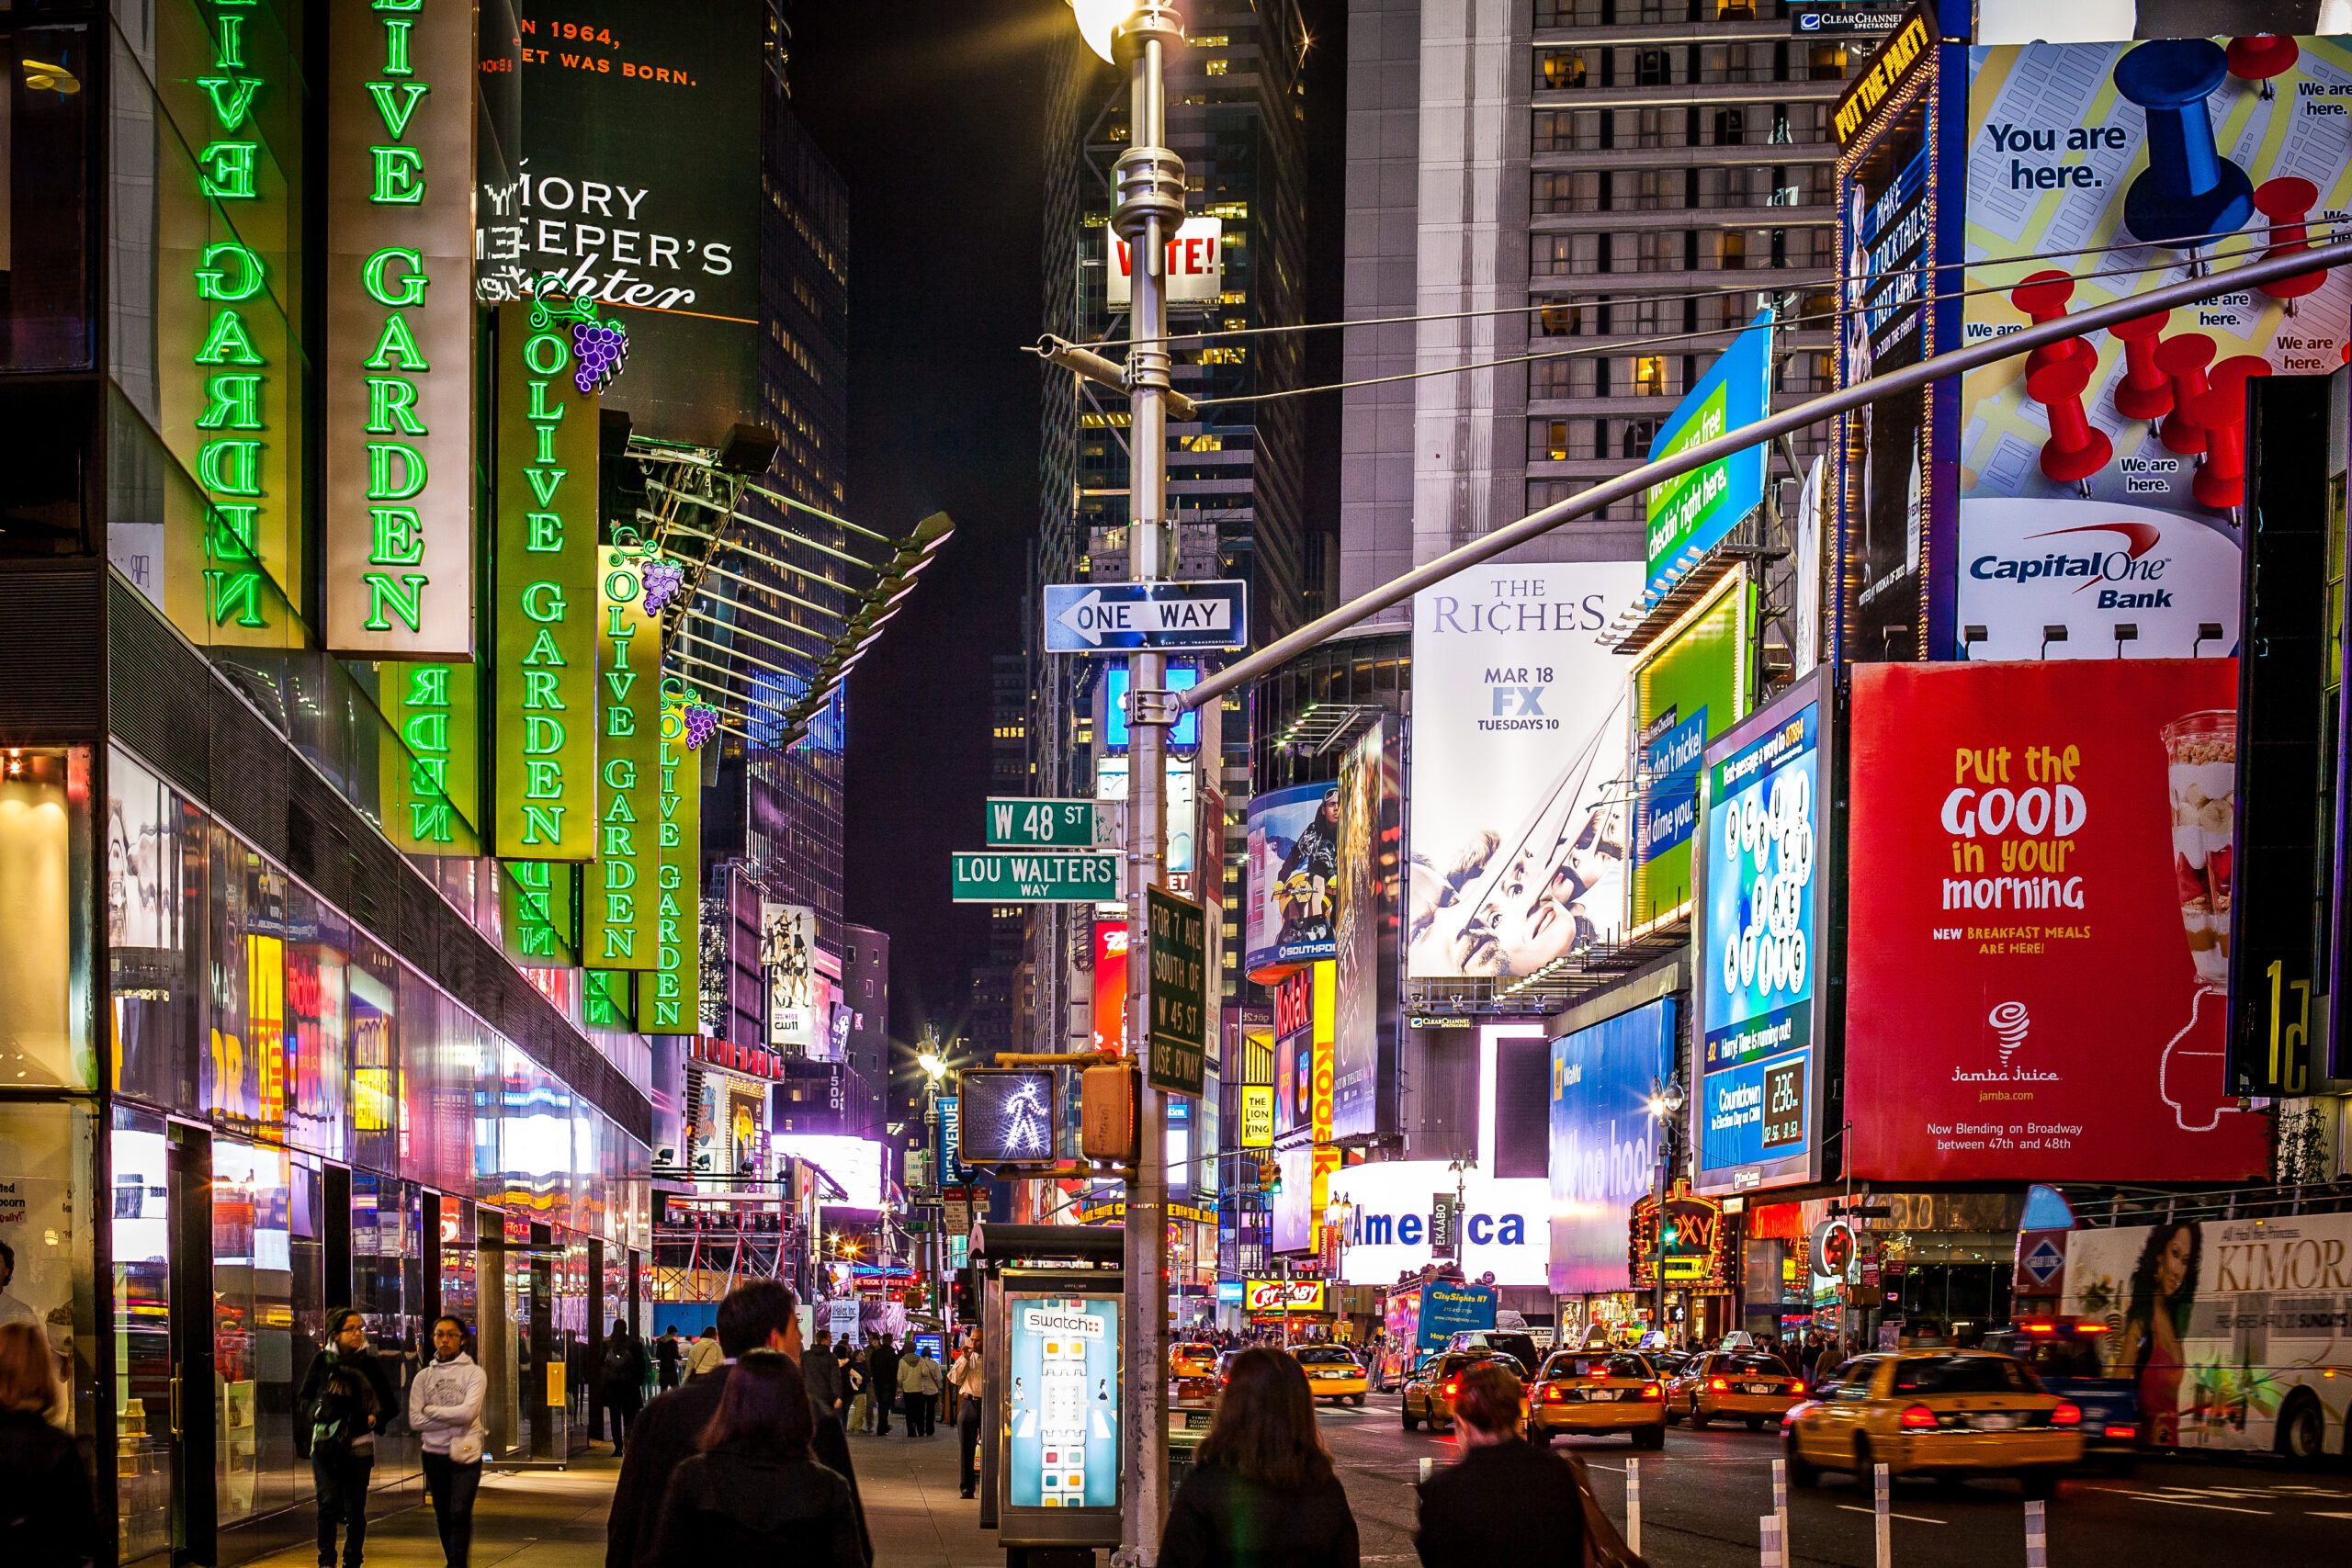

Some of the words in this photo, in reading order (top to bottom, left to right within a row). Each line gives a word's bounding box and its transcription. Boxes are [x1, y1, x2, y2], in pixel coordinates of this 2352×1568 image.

[551, 22, 620, 50] 1964,
[560, 53, 610, 73] WAS
[622, 62, 696, 86] BORN.
[1834, 93, 1862, 143] PUT
[1857, 63, 1888, 113] THE
[1882, 14, 1929, 85] PARTY
[2299, 82, 2325, 96] We
[2328, 84, 2352, 96] are
[2306, 101, 2347, 116] here.
[1986, 124, 2056, 153] You
[2067, 126, 2127, 151] are
[2011, 160, 2103, 190] here.
[1876, 175, 1902, 235] MAKE
[1875, 197, 1928, 281] COCKTAILS
[1117, 237, 1215, 276] VTE!
[1894, 259, 1917, 310] WAR
[2222, 294, 2249, 307] are
[1900, 312, 1917, 339] PARTY
[1967, 323, 1993, 337] We
[2199, 312, 2241, 327] here.
[2277, 336, 2305, 350] We
[2308, 338, 2334, 349] are
[2283, 355, 2325, 369] here.
[364, 248, 430, 631] GARDEN
[525, 334, 569, 553] OLIVE
[2120, 458, 2148, 472] We
[2152, 460, 2177, 471] are
[2128, 477, 2170, 491] here.
[1680, 483, 1702, 535] right
[1702, 466, 1727, 509] here.
[1490, 580, 1545, 597] THE
[2098, 589, 2173, 610] Bank
[1077, 604, 1132, 630] ONE
[1159, 603, 1218, 627] WAY
[604, 569, 639, 738] OLIVE
[1485, 668, 1529, 683] MAR
[1536, 667, 1554, 682] 18
[520, 581, 568, 845] GARDEN
[1492, 686, 1545, 716] FX
[1477, 719, 1544, 731] TUESDAYS
[1545, 719, 1560, 730] 10
[1654, 740, 1675, 785] don't
[1675, 719, 1702, 770] nickel
[2024, 744, 2081, 784] the
[658, 712, 682, 848] OLIVE
[994, 804, 1014, 840] W
[1023, 805, 1054, 841] 48
[1064, 806, 1085, 825] ST
[1653, 807, 1672, 844] dime
[1673, 798, 1693, 841] you.
[1940, 784, 2087, 839] GOOD
[602, 758, 637, 960] GARDEN
[958, 858, 1001, 883] LOU
[1011, 858, 1112, 883] WALTERS
[1952, 841, 1984, 873] in
[2001, 840, 2075, 874] your
[1020, 884, 1050, 897] WAY
[1151, 903, 1170, 939] FOR
[1184, 918, 1202, 952] AVE
[1933, 928, 1962, 941] NEW
[1967, 926, 2041, 939] BREAKFAST
[2044, 925, 2091, 939] MEALS
[655, 863, 682, 1027] GARDEN
[1979, 943, 2005, 954] ARE
[2009, 942, 2044, 954] HERE!
[1155, 950, 1185, 988] SOUTH
[1188, 964, 1200, 993] OF
[1159, 996, 1167, 1028] W
[1170, 1002, 1183, 1032] 45
[1276, 969, 1309, 1037] Kodak
[1153, 1043, 1171, 1077] USE
[1174, 1048, 1201, 1089] B'WAY
[1563, 1063, 1583, 1087] WaMu
[830, 1064, 840, 1110] 1500
[1249, 1097, 1267, 1106] THE
[1718, 1083, 1761, 1113] Countdown
[1979, 1090, 2034, 1102] jamba.com
[1246, 1108, 1269, 1122] LION
[1314, 1041, 1339, 1179] Kodak
[1245, 1123, 1270, 1138] KING
[1927, 1122, 1952, 1135] Now
[1956, 1122, 2004, 1136] Blending
[2008, 1125, 2023, 1134] on
[2027, 1122, 2083, 1136] Broadway
[1938, 1139, 1985, 1149] between
[1989, 1138, 2014, 1149] 47th
[2019, 1139, 2041, 1149] and
[2044, 1138, 2071, 1149] 48th
[974, 1202, 988, 1211] TOUR
[1353, 1203, 1525, 1247] Ameca
[1432, 1291, 1476, 1303] CitySights
[1476, 1294, 1488, 1303] NY
[1030, 1314, 1088, 1331] swatch
[1430, 1332, 1445, 1341] Hop
